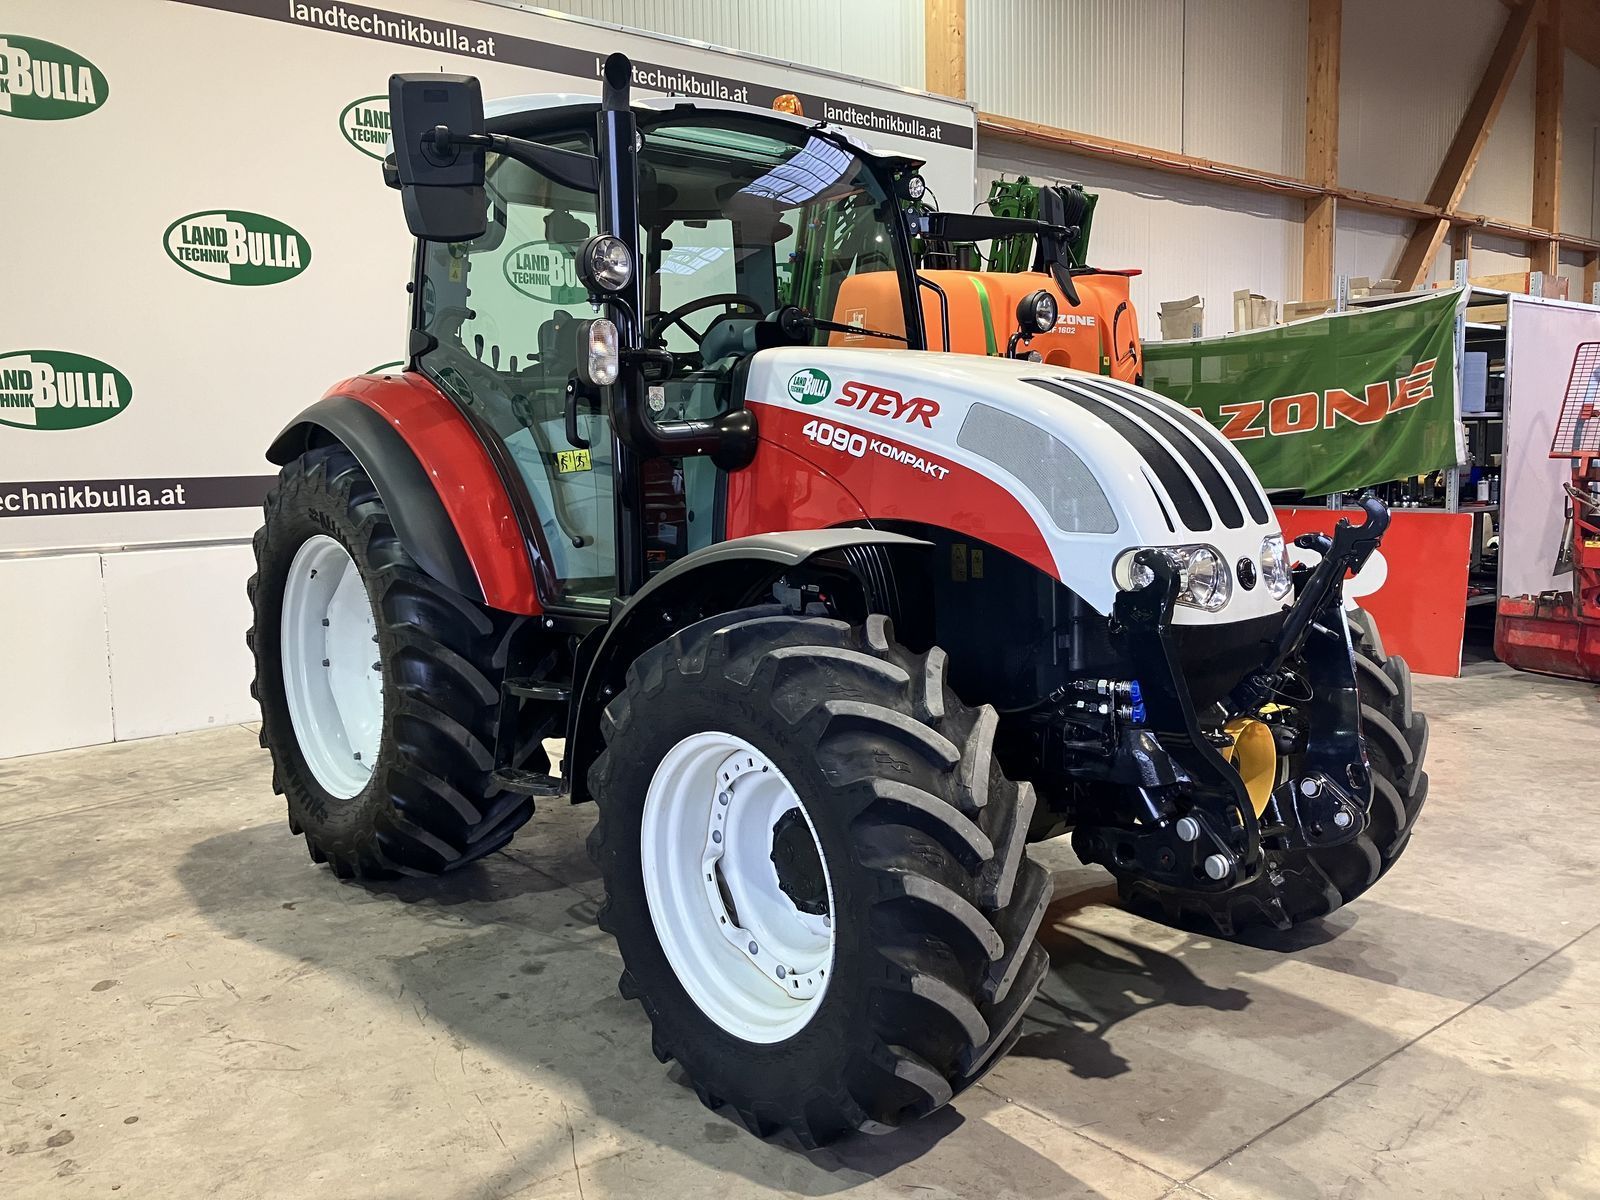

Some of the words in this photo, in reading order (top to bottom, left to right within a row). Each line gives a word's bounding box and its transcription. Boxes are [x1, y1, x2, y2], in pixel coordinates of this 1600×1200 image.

[289, 0, 496, 57] landtechnikbulla.at
[9, 46, 97, 105] BULLA
[595, 57, 749, 103] ltechnikbulla.at
[351, 127, 391, 144] TECHNI
[823, 102, 942, 140] landtechnikbulla.at
[181, 224, 228, 247] LAND
[227, 221, 302, 269] BULLA
[176, 246, 230, 264] TECHNIK
[516, 253, 550, 271] LAND
[512, 271, 551, 286] TECHNIK
[1057, 314, 1096, 326] ZONE
[1058, 326, 1076, 334] 1602
[31, 361, 120, 409] BULLA
[793, 376, 807, 387] LAND
[803, 373, 829, 398] BULLA
[834, 380, 941, 429] STEYR
[1190, 357, 1438, 441] ZONE
[802, 420, 868, 458] 4090
[869, 438, 950, 481] KOMPAKT
[0, 483, 186, 512] chnikbulla.at
